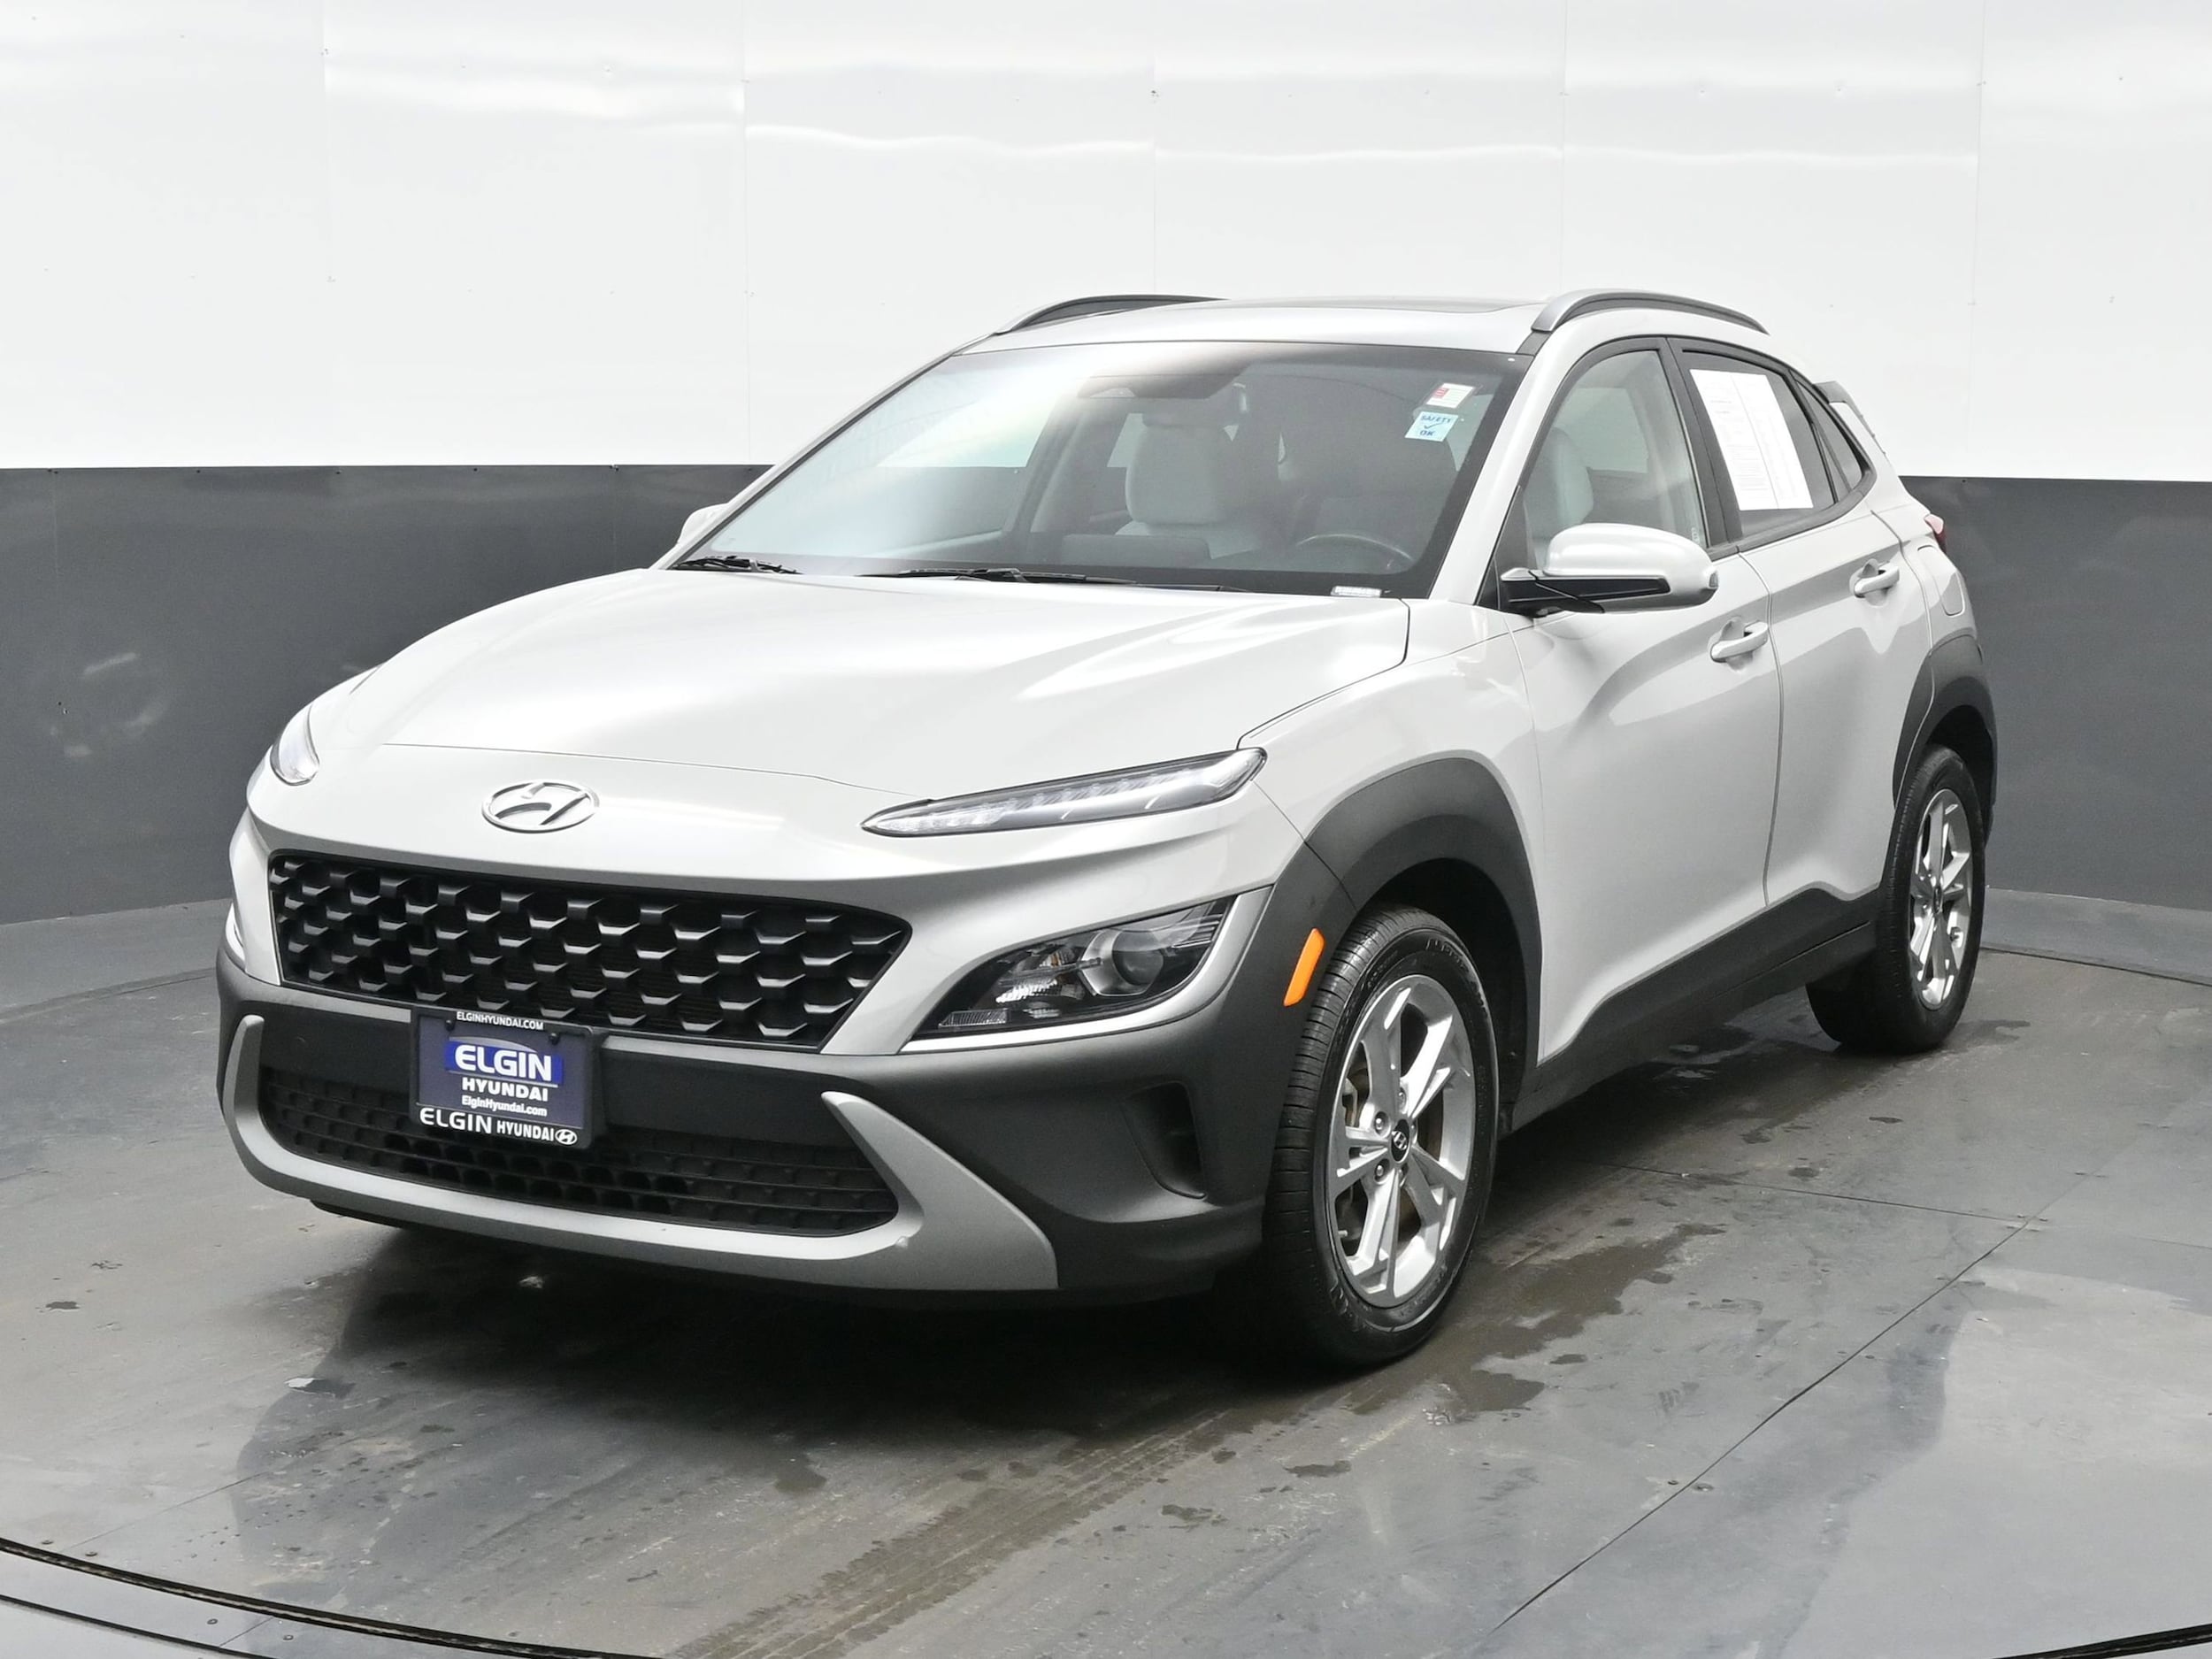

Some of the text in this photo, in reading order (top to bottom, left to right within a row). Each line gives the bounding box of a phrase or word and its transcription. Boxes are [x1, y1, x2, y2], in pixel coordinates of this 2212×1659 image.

[456, 1010, 544, 1031] ELGINHYUNDAI.COM
[455, 1044, 551, 1081] ELGIN
[462, 1077, 549, 1102] HYUNDAI
[462, 1095, 548, 1117] ElginHyundai.com
[419, 1107, 554, 1141] ELGIN HYUNDAI
